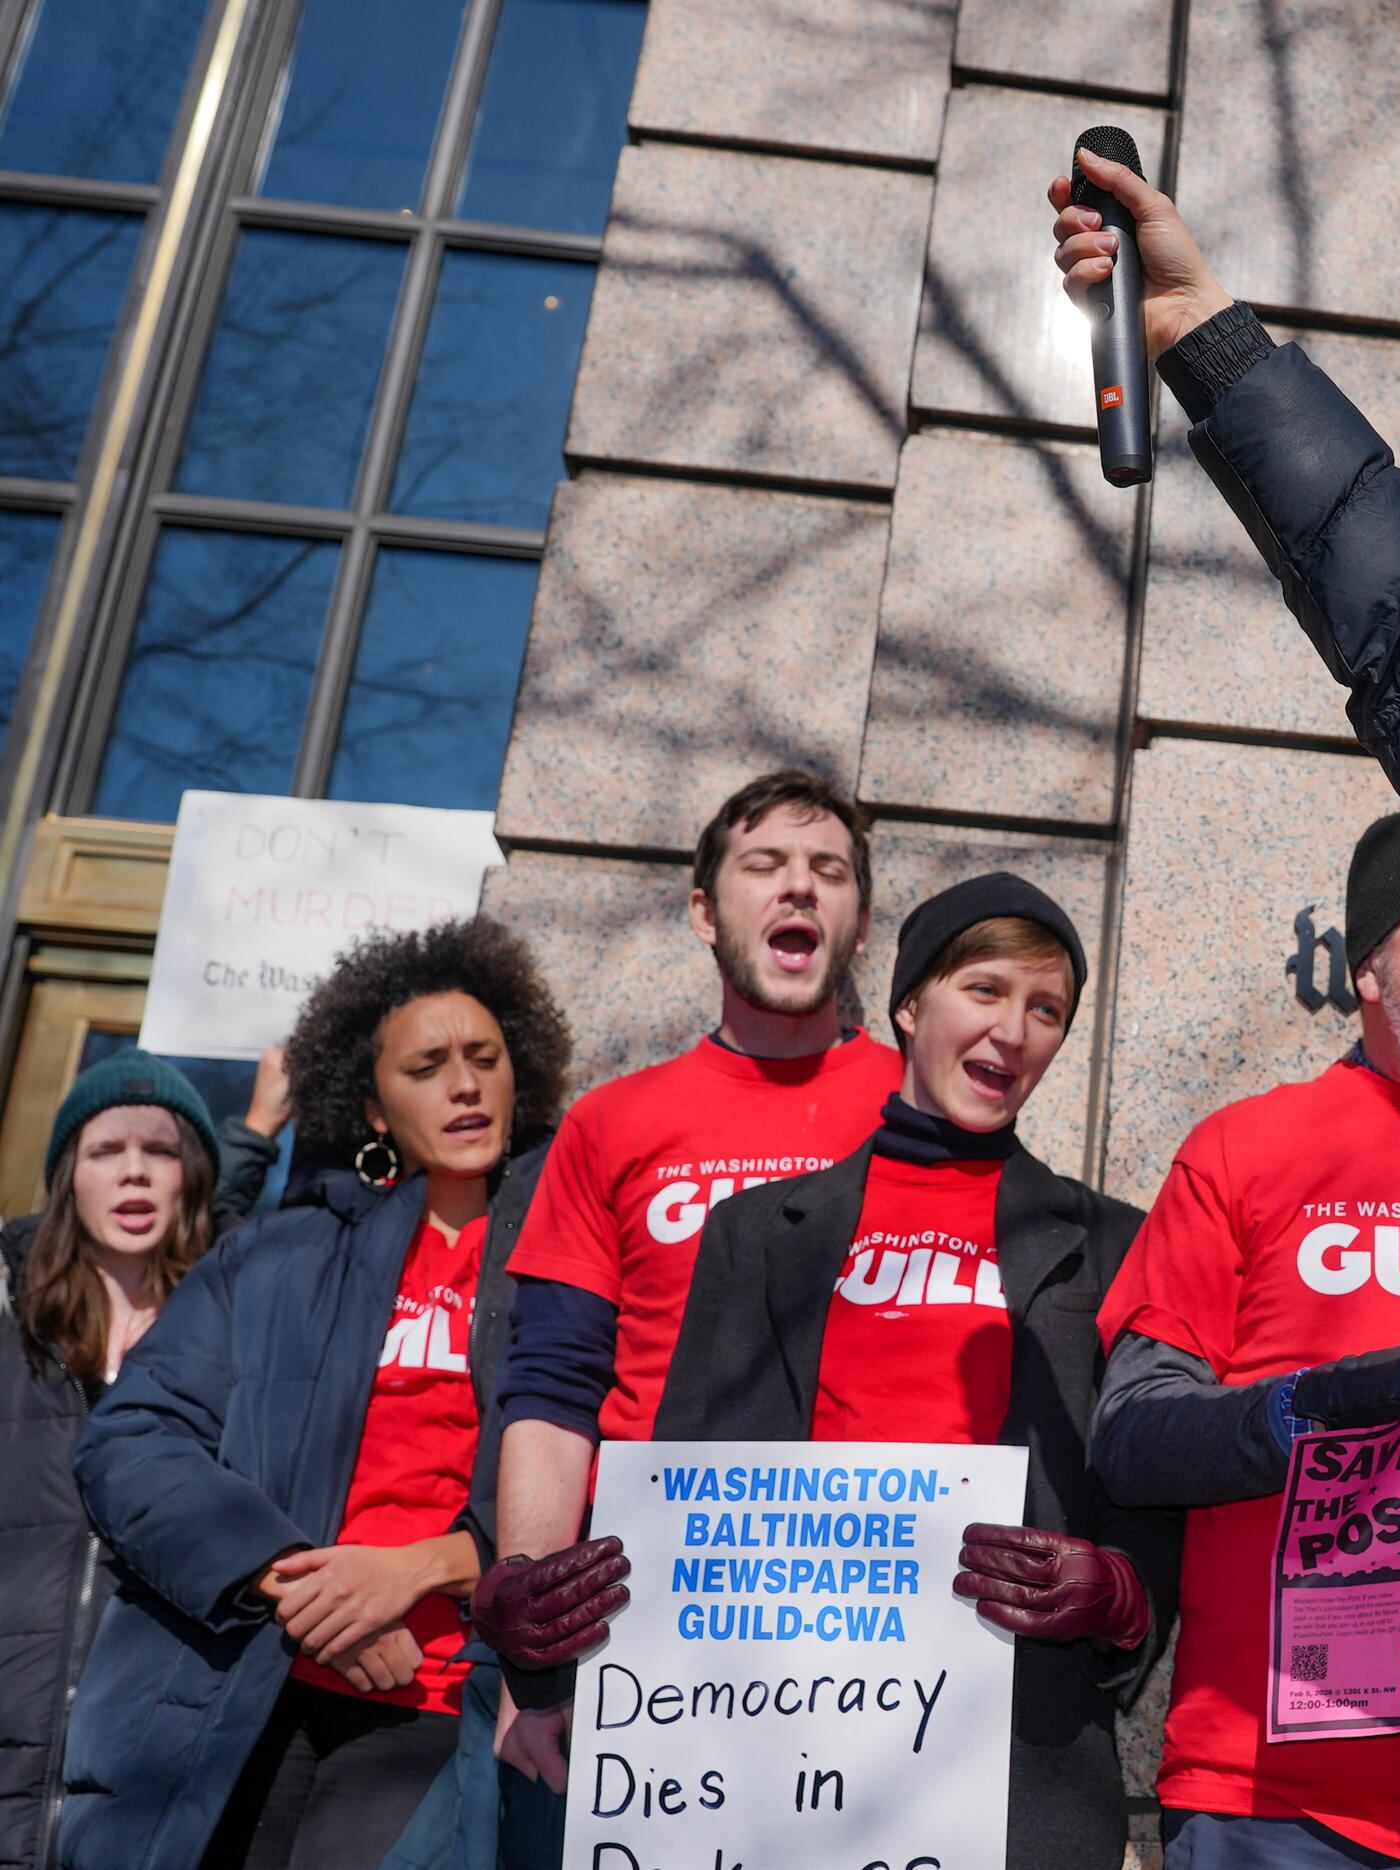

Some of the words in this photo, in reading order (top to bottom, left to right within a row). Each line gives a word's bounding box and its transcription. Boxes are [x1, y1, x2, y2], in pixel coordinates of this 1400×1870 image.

[235, 822, 405, 866] DON'T
[204, 960, 249, 987] The
[657, 1163, 692, 1180] THE
[700, 1157, 834, 1176] WASHINGTON
[1303, 1201, 1347, 1218] THE
[834, 1248, 1008, 1309] UIL
[663, 1467, 949, 1502] WASHINGTON-
[1294, 1489, 1361, 1523] THE
[684, 1512, 917, 1548] BALTIMORE
[672, 1558, 920, 1594] NEWSPAPER
[678, 1603, 906, 1642] GUILD-CWA
[595, 1663, 947, 1754] Democracy
[1288, 1698, 1369, 1710] 12:00-1:00pm
[1289, 1689, 1303, 1698] Feb
[1343, 1686, 1362, 1695] 1301
[1383, 1685, 1397, 1693] NW
[591, 1753, 726, 1818] Dies
[796, 1752, 844, 1812] in
